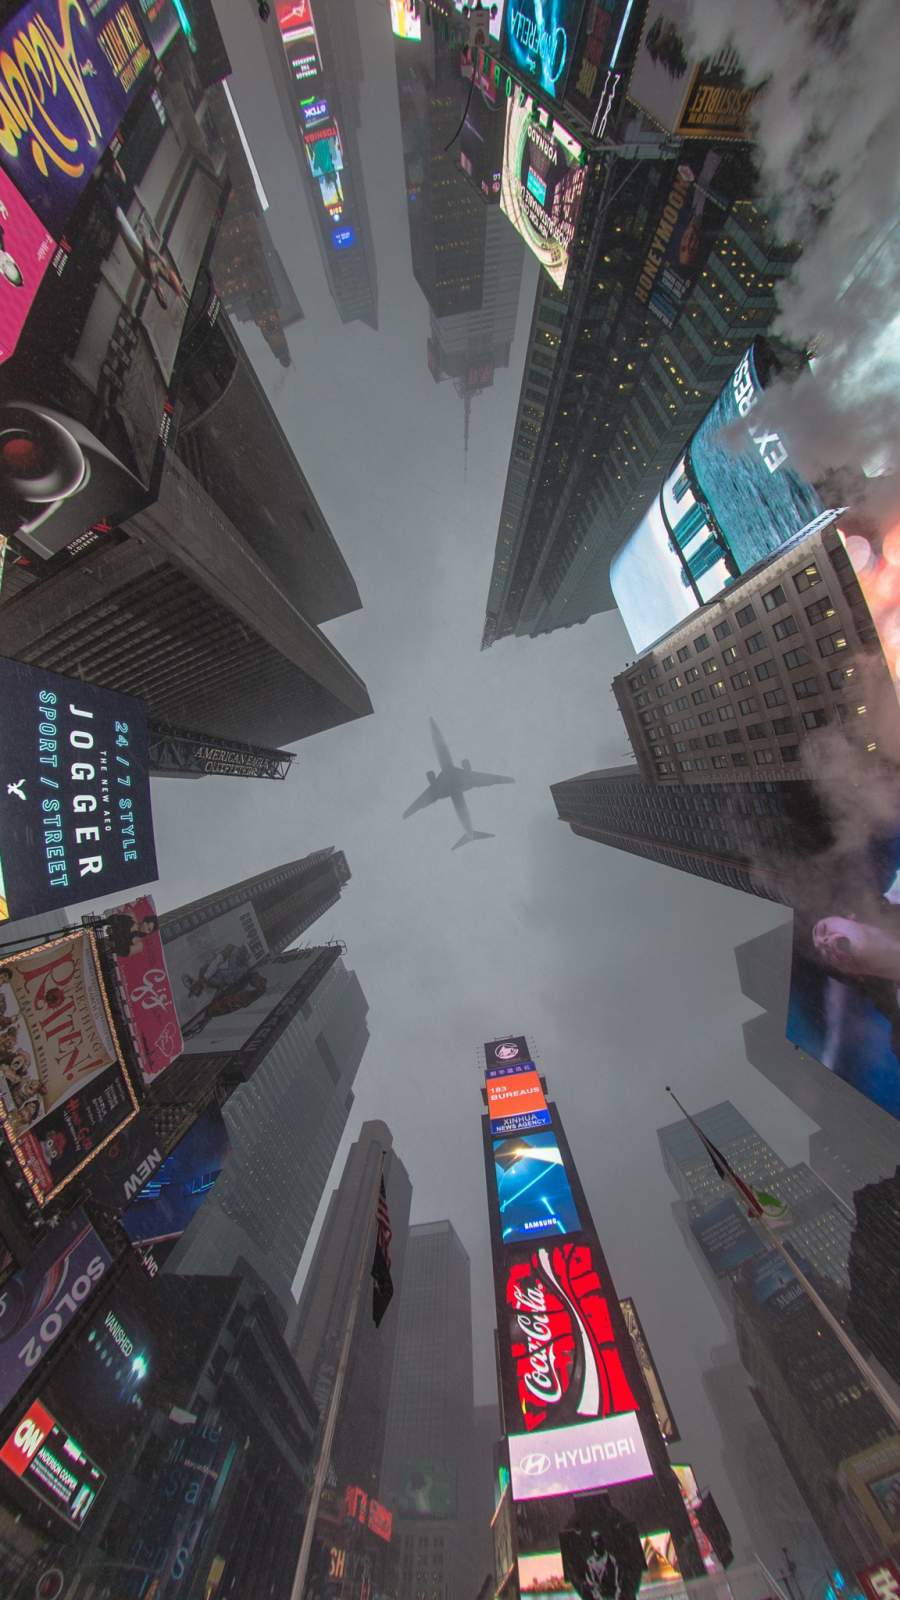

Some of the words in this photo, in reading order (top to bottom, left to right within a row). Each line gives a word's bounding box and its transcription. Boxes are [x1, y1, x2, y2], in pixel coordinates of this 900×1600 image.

[304, 105, 320, 118] TDK
[304, 127, 337, 143] TOSHIBA
[528, 125, 557, 166] VORNADO
[39, 689, 58, 768] SPORT
[100, 751, 108, 771] THE
[194, 746, 246, 765] AMERICAN
[69, 703, 104, 878] JOGGER
[101, 781, 109, 803] NEW
[103, 810, 111, 832] AEO
[119, 798, 138, 863] STYLE
[42, 799, 69, 888] STREET
[72, 956, 102, 1058] SOMETHING
[490, 1086, 540, 1101] BUREAUS
[496, 1122, 517, 1132] NEWS
[517, 1117, 547, 1129] AGENCY
[503, 1114, 538, 1126] XINHUA
[124, 1148, 162, 1200] NEW
[524, 1218, 558, 1230] SAMSUNG
[104, 1311, 134, 1357] VANISHED
[513, 1279, 562, 1403] Coca-Cola
[13, 1418, 46, 1457] CNN
[554, 1437, 636, 1470] HYUNDAI
